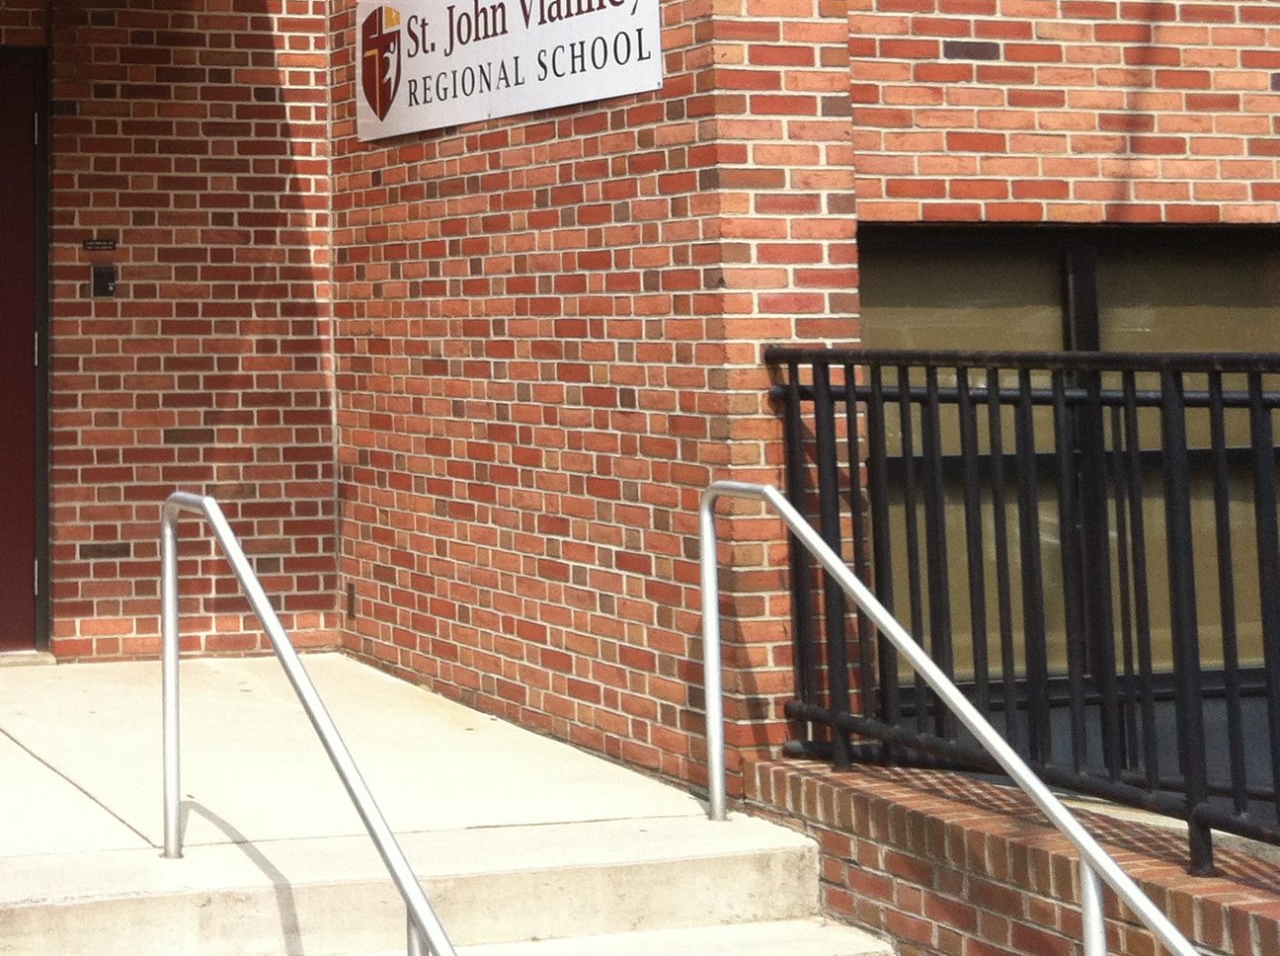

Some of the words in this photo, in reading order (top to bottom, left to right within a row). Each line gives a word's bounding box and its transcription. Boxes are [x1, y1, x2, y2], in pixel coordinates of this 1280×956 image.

[407, 14, 436, 58] St.
[407, 55, 525, 107] REGIONAL
[537, 27, 651, 81] SCHOOL
